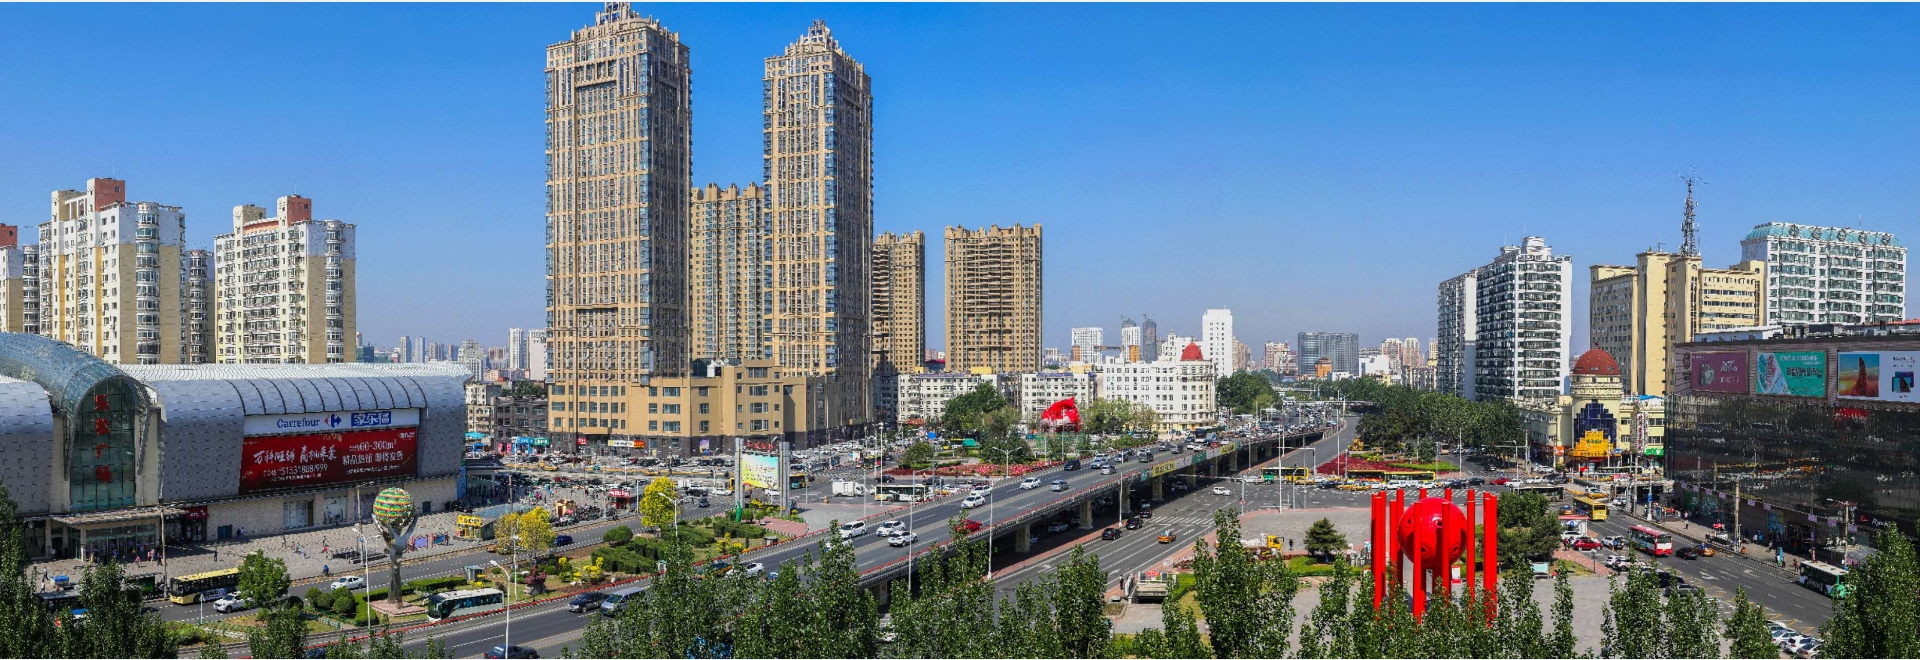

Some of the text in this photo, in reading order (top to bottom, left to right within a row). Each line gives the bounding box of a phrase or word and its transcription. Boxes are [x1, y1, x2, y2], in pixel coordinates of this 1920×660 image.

[276, 417, 321, 429] Carrefour
[353, 412, 390, 426] 家乐福
